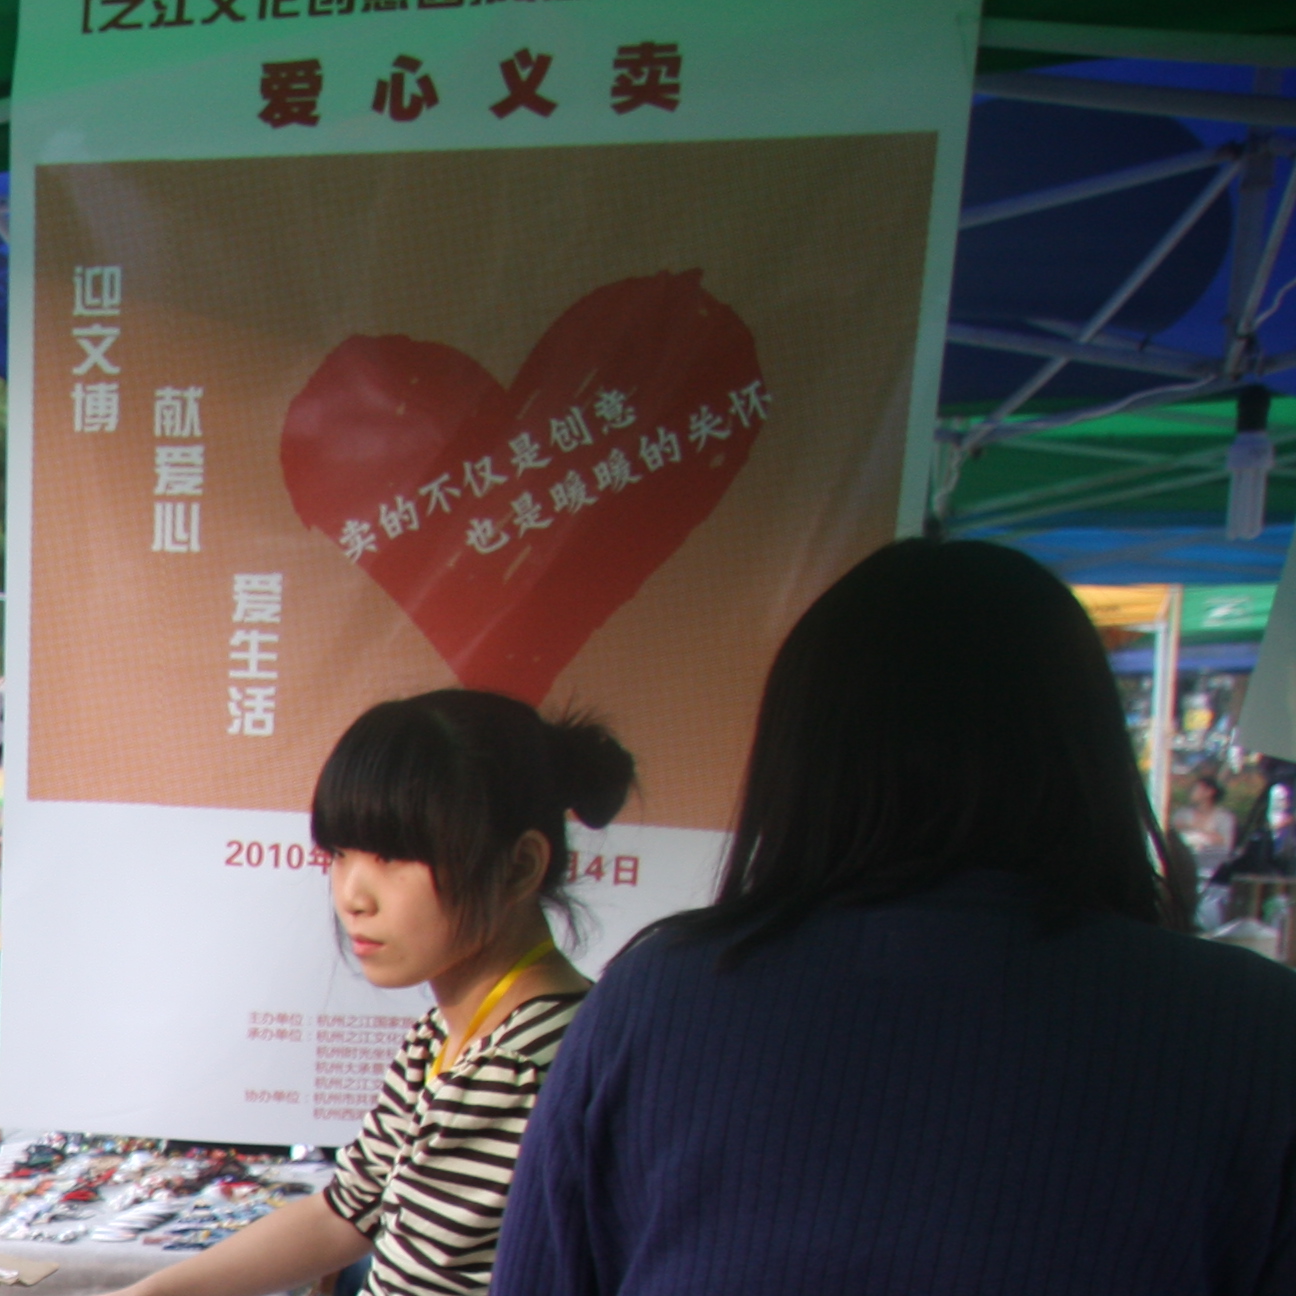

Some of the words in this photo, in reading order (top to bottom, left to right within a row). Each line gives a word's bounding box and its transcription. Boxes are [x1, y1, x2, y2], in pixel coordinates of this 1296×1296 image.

[257, 41, 683, 130] 爱心义卖
[71, 265, 122, 433] 迎文博
[151, 386, 205, 554] 献爱心
[339, 387, 637, 563] 卖的不仅是创意
[465, 380, 773, 555] 也是暖暖的关怀
[227, 572, 284, 737] 爱生活
